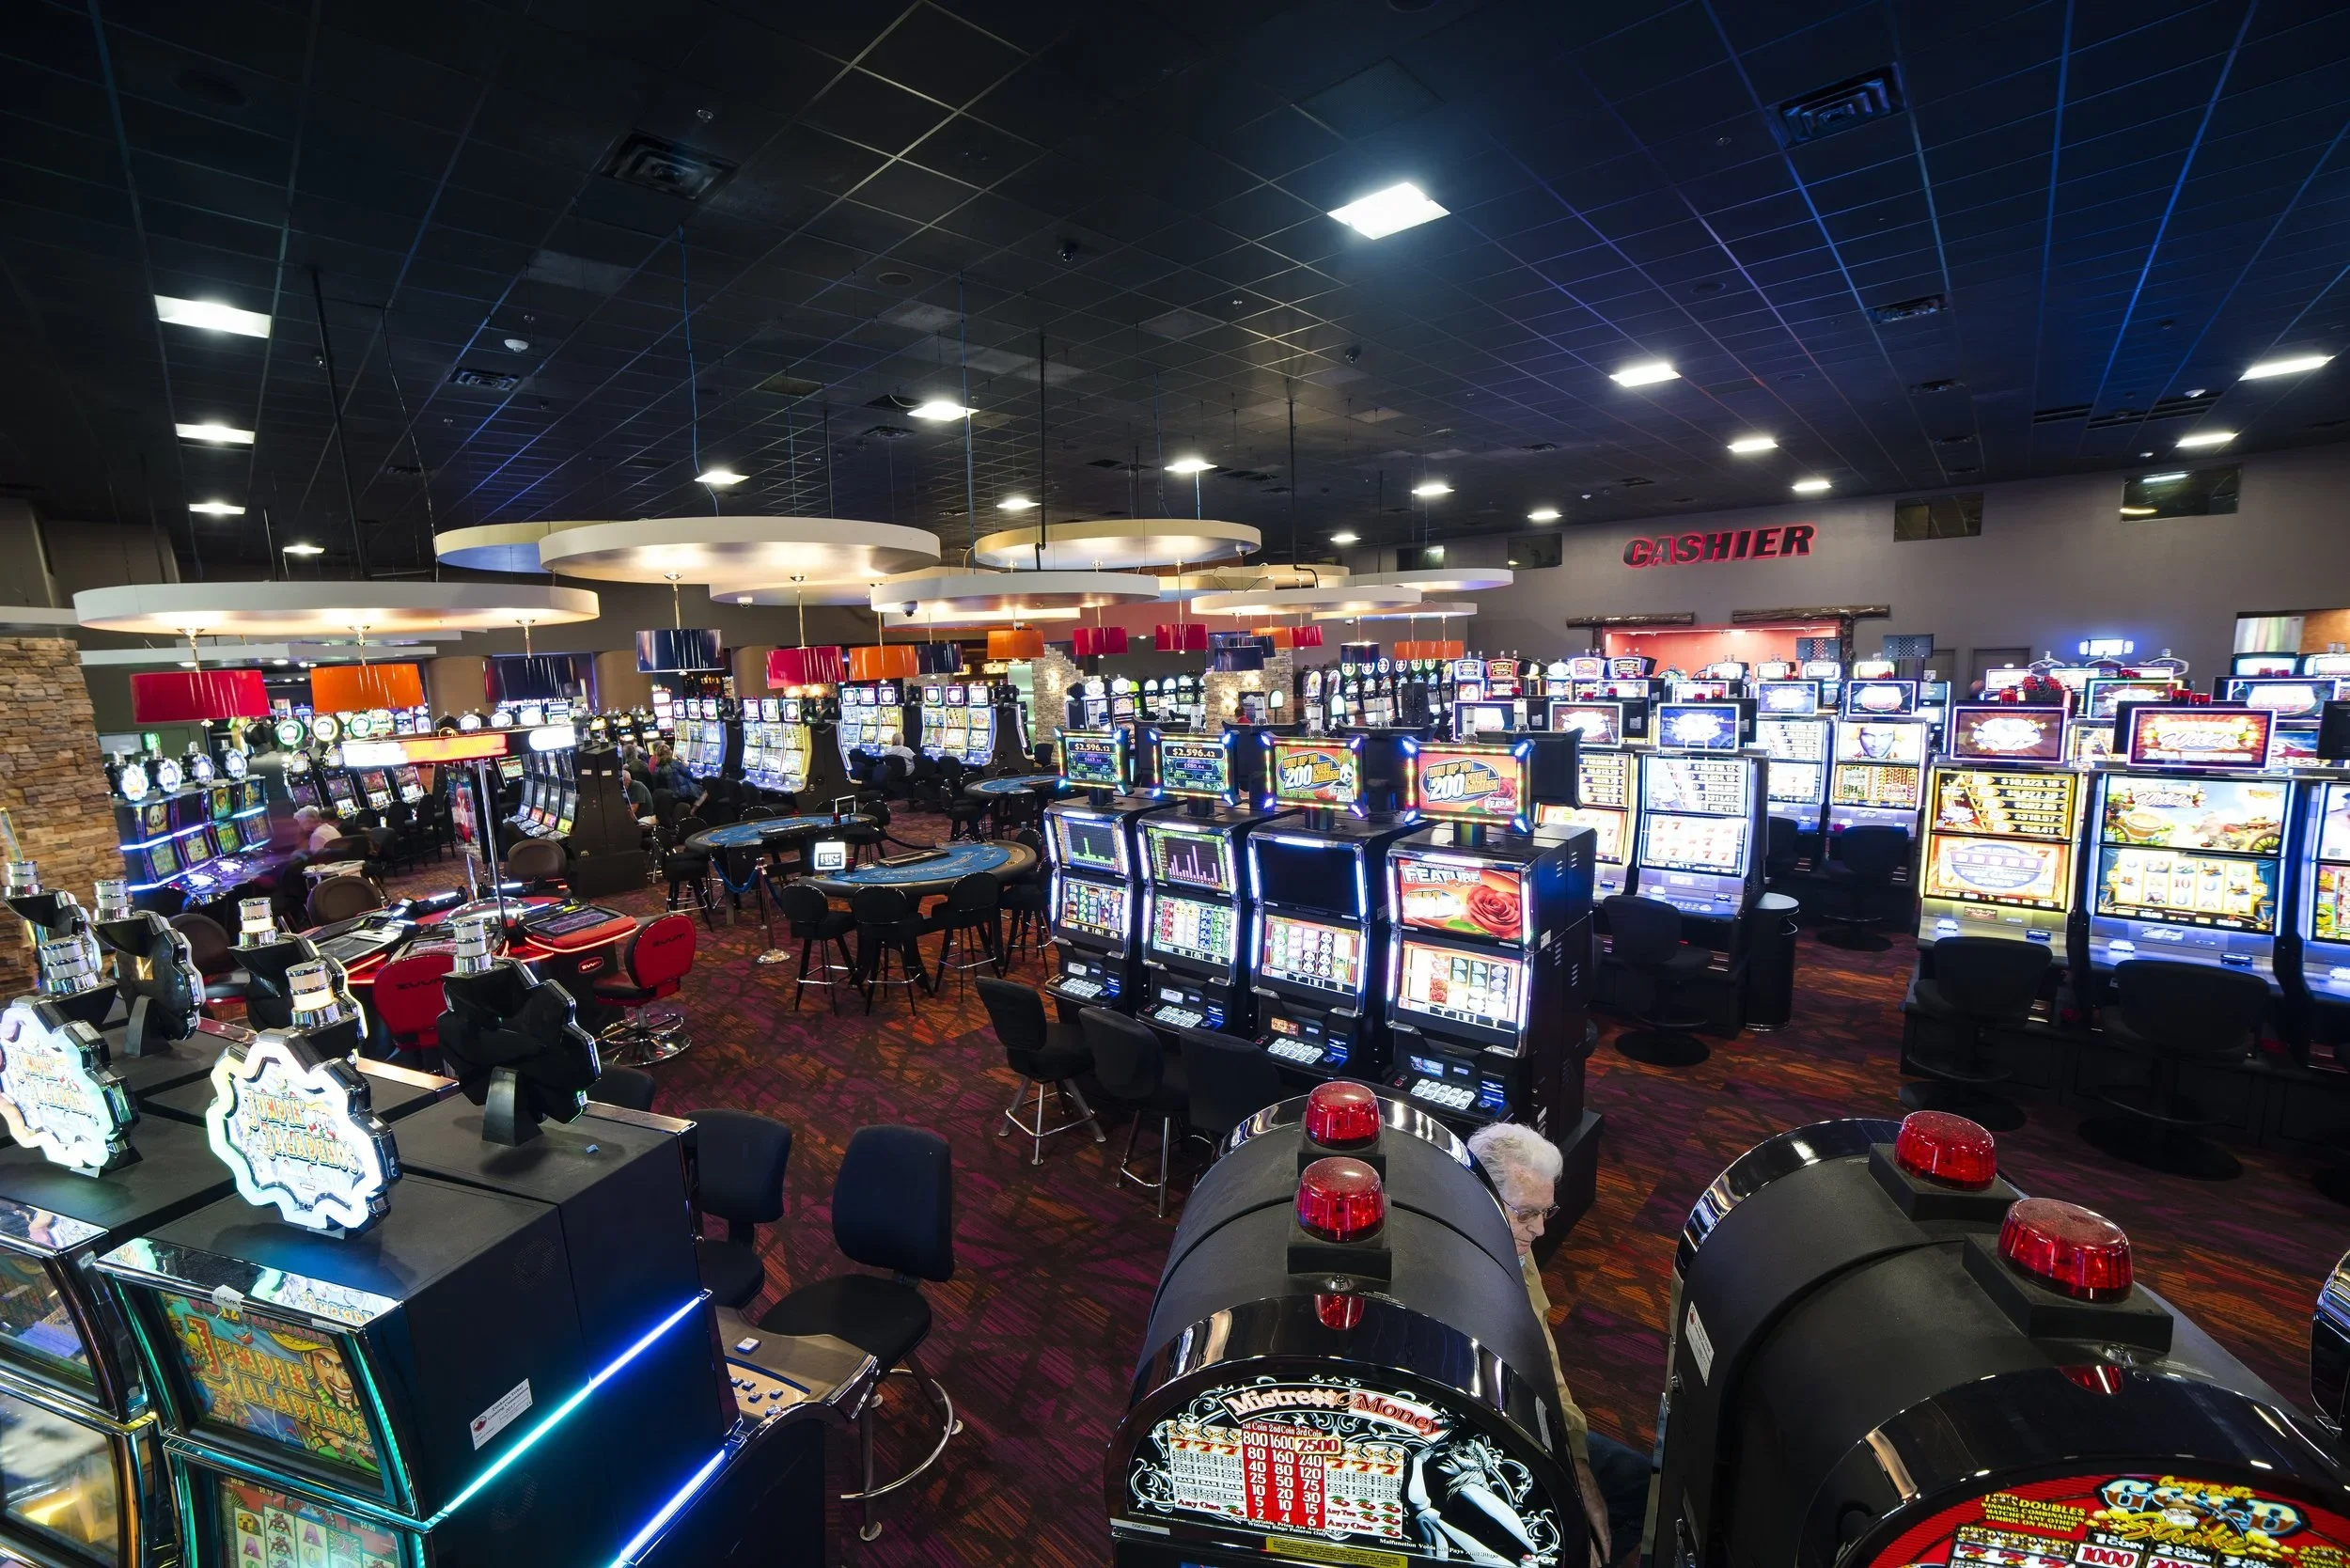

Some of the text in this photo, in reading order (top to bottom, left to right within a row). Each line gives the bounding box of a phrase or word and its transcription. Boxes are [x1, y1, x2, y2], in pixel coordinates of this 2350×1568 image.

[1623, 525, 1814, 567] CASHIER
[1074, 743, 1110, 752] $2,596.12
[1172, 747, 1215, 758] $2,596.42
[1283, 753, 1318, 769] WIN UP TO
[1313, 762, 1331, 773] FREE
[1429, 760, 1471, 776] WIN UP TO
[1284, 764, 1313, 790] 200
[1465, 771, 1488, 784] FREE
[1428, 773, 1465, 801] 200
[1465, 780, 1499, 794] GAMES!
[1403, 867, 1481, 885] FEATURE
[2173, 877, 2191, 888] 10
[1224, 1388, 1336, 1417] Mistre$$
[1354, 1392, 1442, 1436] Money
[1252, 1422, 1268, 1432] Coin
[1281, 1426, 1295, 1435] Coin
[1295, 1428, 1323, 1438] 3rd Coin
[1243, 1431, 1339, 1452] 800 1600 2500
[1247, 1447, 1266, 1460] 80
[1272, 1450, 1294, 1465] 160
[1299, 1454, 1323, 1467] 240
[1248, 1461, 1322, 1480] 40 80 120
[1249, 1472, 1266, 1484] 25
[1276, 1476, 1294, 1488] 50
[1301, 1479, 1320, 1491] 75
[1252, 1484, 1321, 1503] 10 20 30
[1177, 1498, 1221, 1511] Any One
[1255, 1497, 1319, 1514] 5 10 15
[1326, 1508, 1356, 1517] Any Two
[1982, 1502, 2085, 1523] WINNING COMBINATION
[2019, 1499, 2086, 1516] DOUBLES
[1247, 1521, 1271, 1529] Winning
[1256, 1508, 1264, 1519] 2
[1281, 1512, 1291, 1523] 4
[1308, 1515, 1317, 1527] 6
[1327, 1519, 1373, 1531] Any One
[1985, 1509, 2078, 1528] MATCHES ANY OTHER
[1985, 1514, 2020, 1525] SYMBOL
[2038, 1521, 2073, 1533] PAYLINE
[1379, 1537, 1417, 1549] Malfunction
[1418, 1543, 1436, 1551] Voids
[1531, 1554, 1559, 1566] VGT
[2082, 1546, 2135, 1568] 1000
